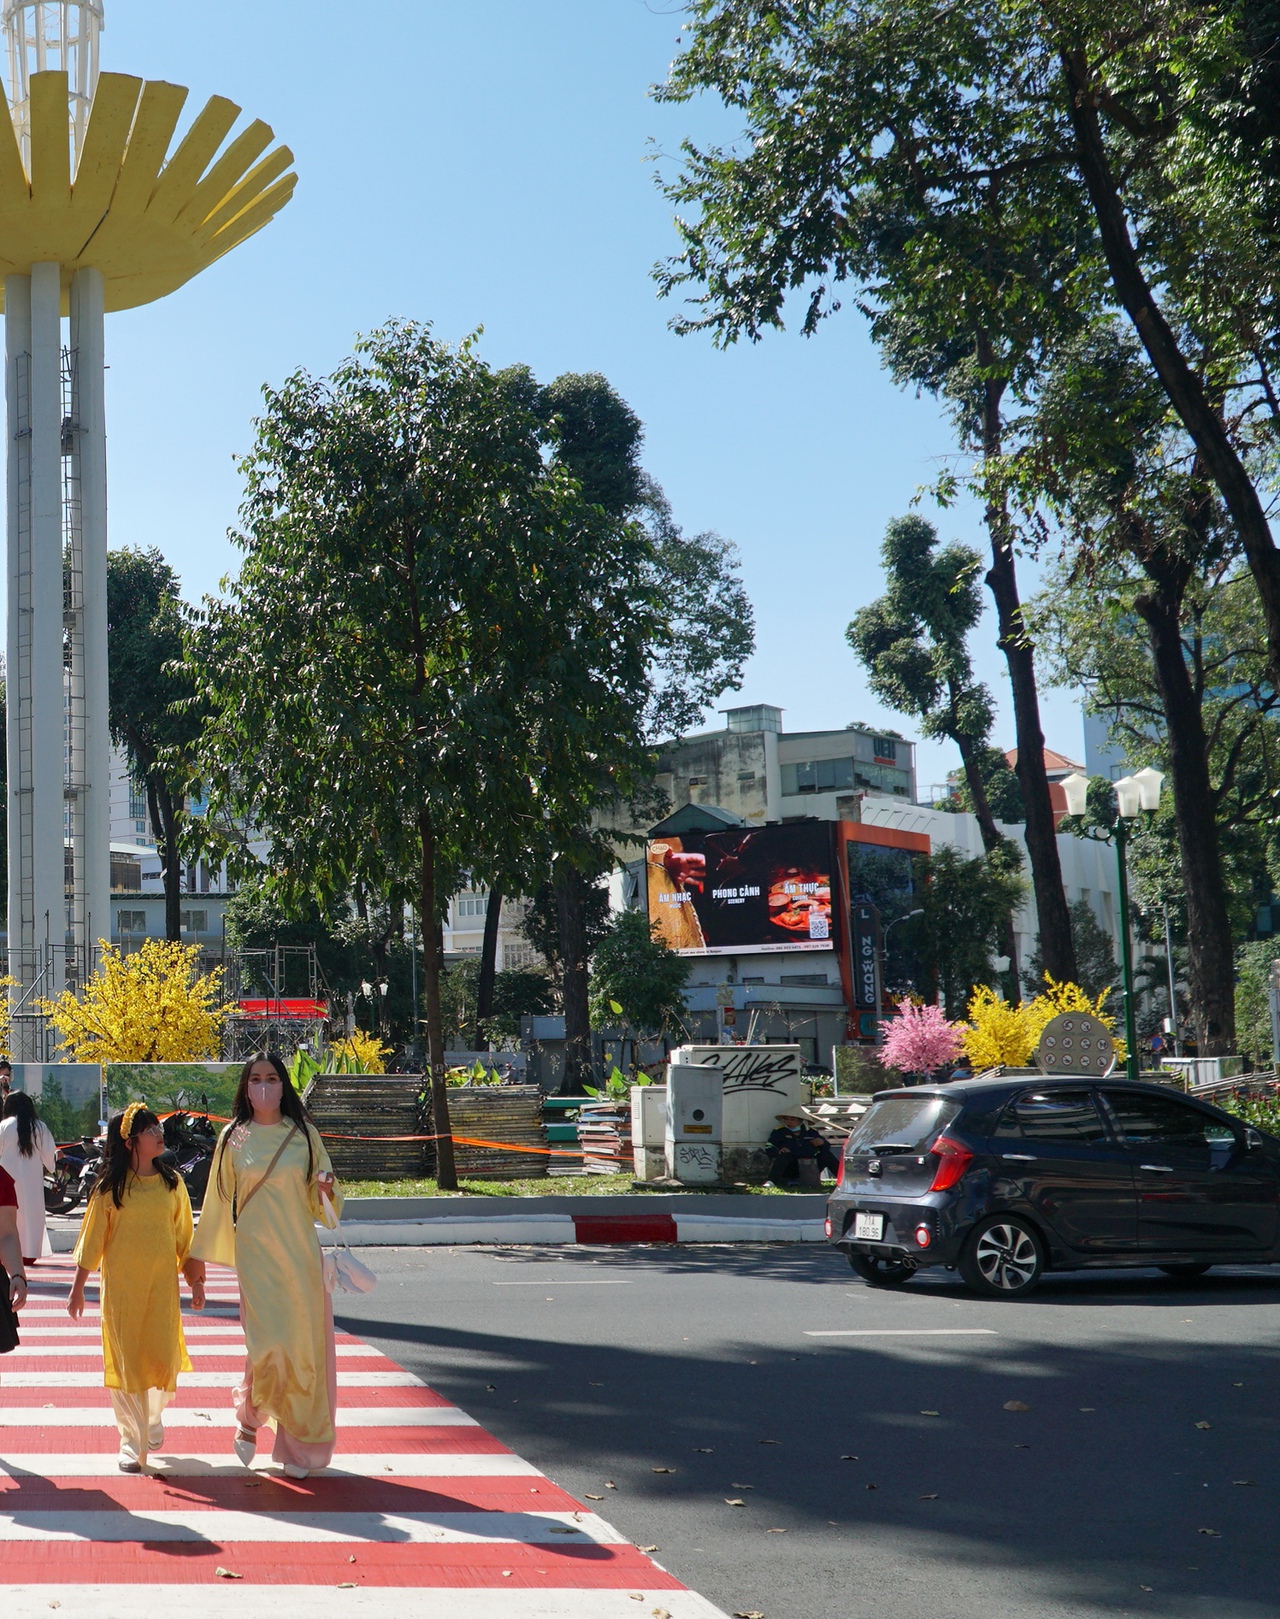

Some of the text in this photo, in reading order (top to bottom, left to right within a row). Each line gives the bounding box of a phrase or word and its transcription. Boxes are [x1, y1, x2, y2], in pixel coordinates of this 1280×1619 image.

[712, 884, 761, 899] PHONG CẢNH
[798, 882, 819, 895] THỰC
[671, 891, 692, 903] NHẠC
[864, 1214, 875, 1225] 71A
[859, 1226, 880, 1238] 180.96
